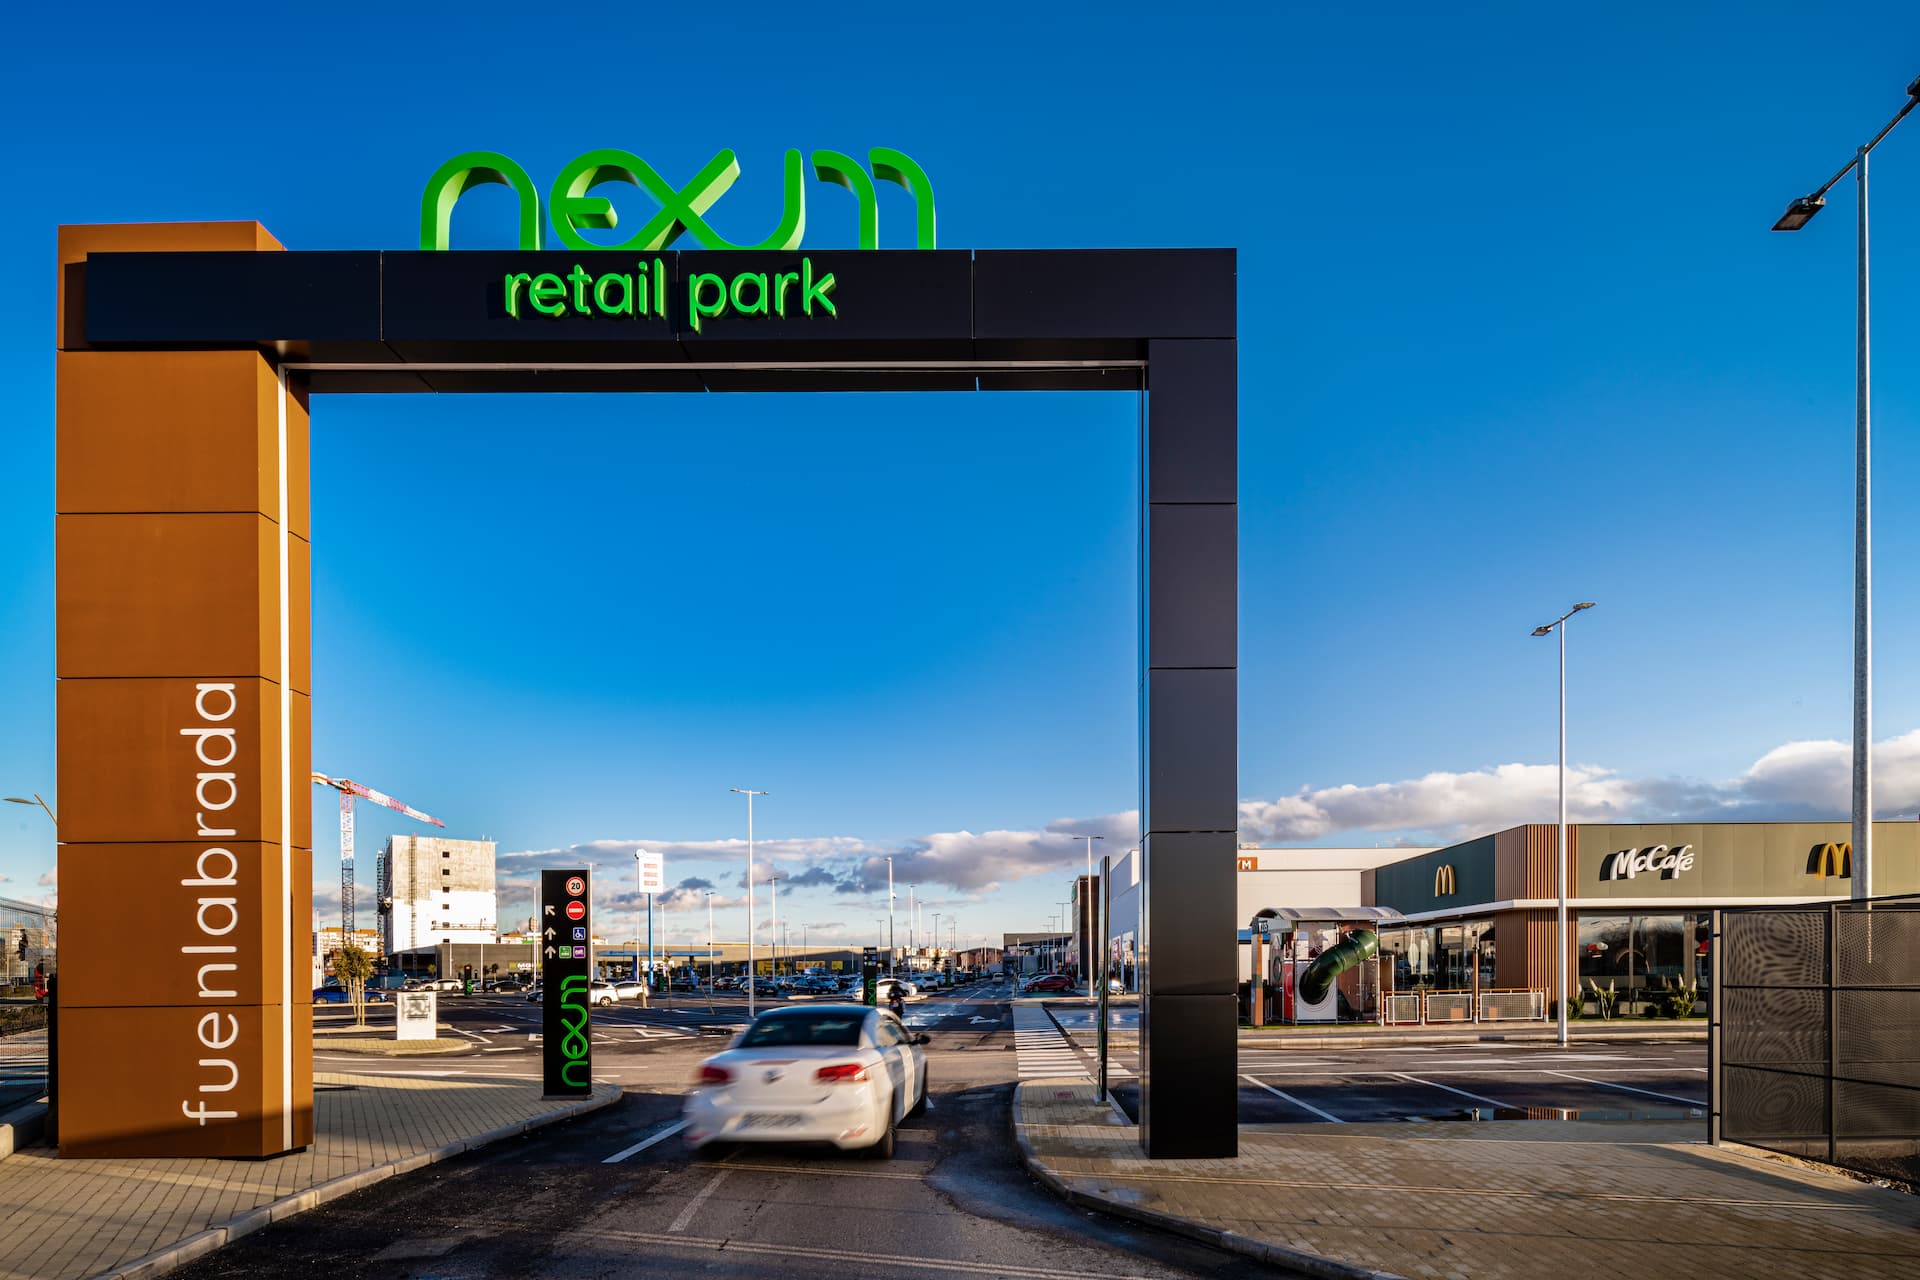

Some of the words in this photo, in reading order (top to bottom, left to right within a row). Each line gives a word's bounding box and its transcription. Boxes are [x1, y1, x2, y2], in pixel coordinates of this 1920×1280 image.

[420, 148, 937, 250] nexum
[504, 257, 668, 319] retail
[688, 257, 839, 333] park
[571, 882, 581, 890] 20
[1238, 860, 1252, 870] M
[1609, 844, 1694, 880] McCafé
[180, 682, 239, 1127] fuenlabrada
[560, 974, 588, 1087] nexum
